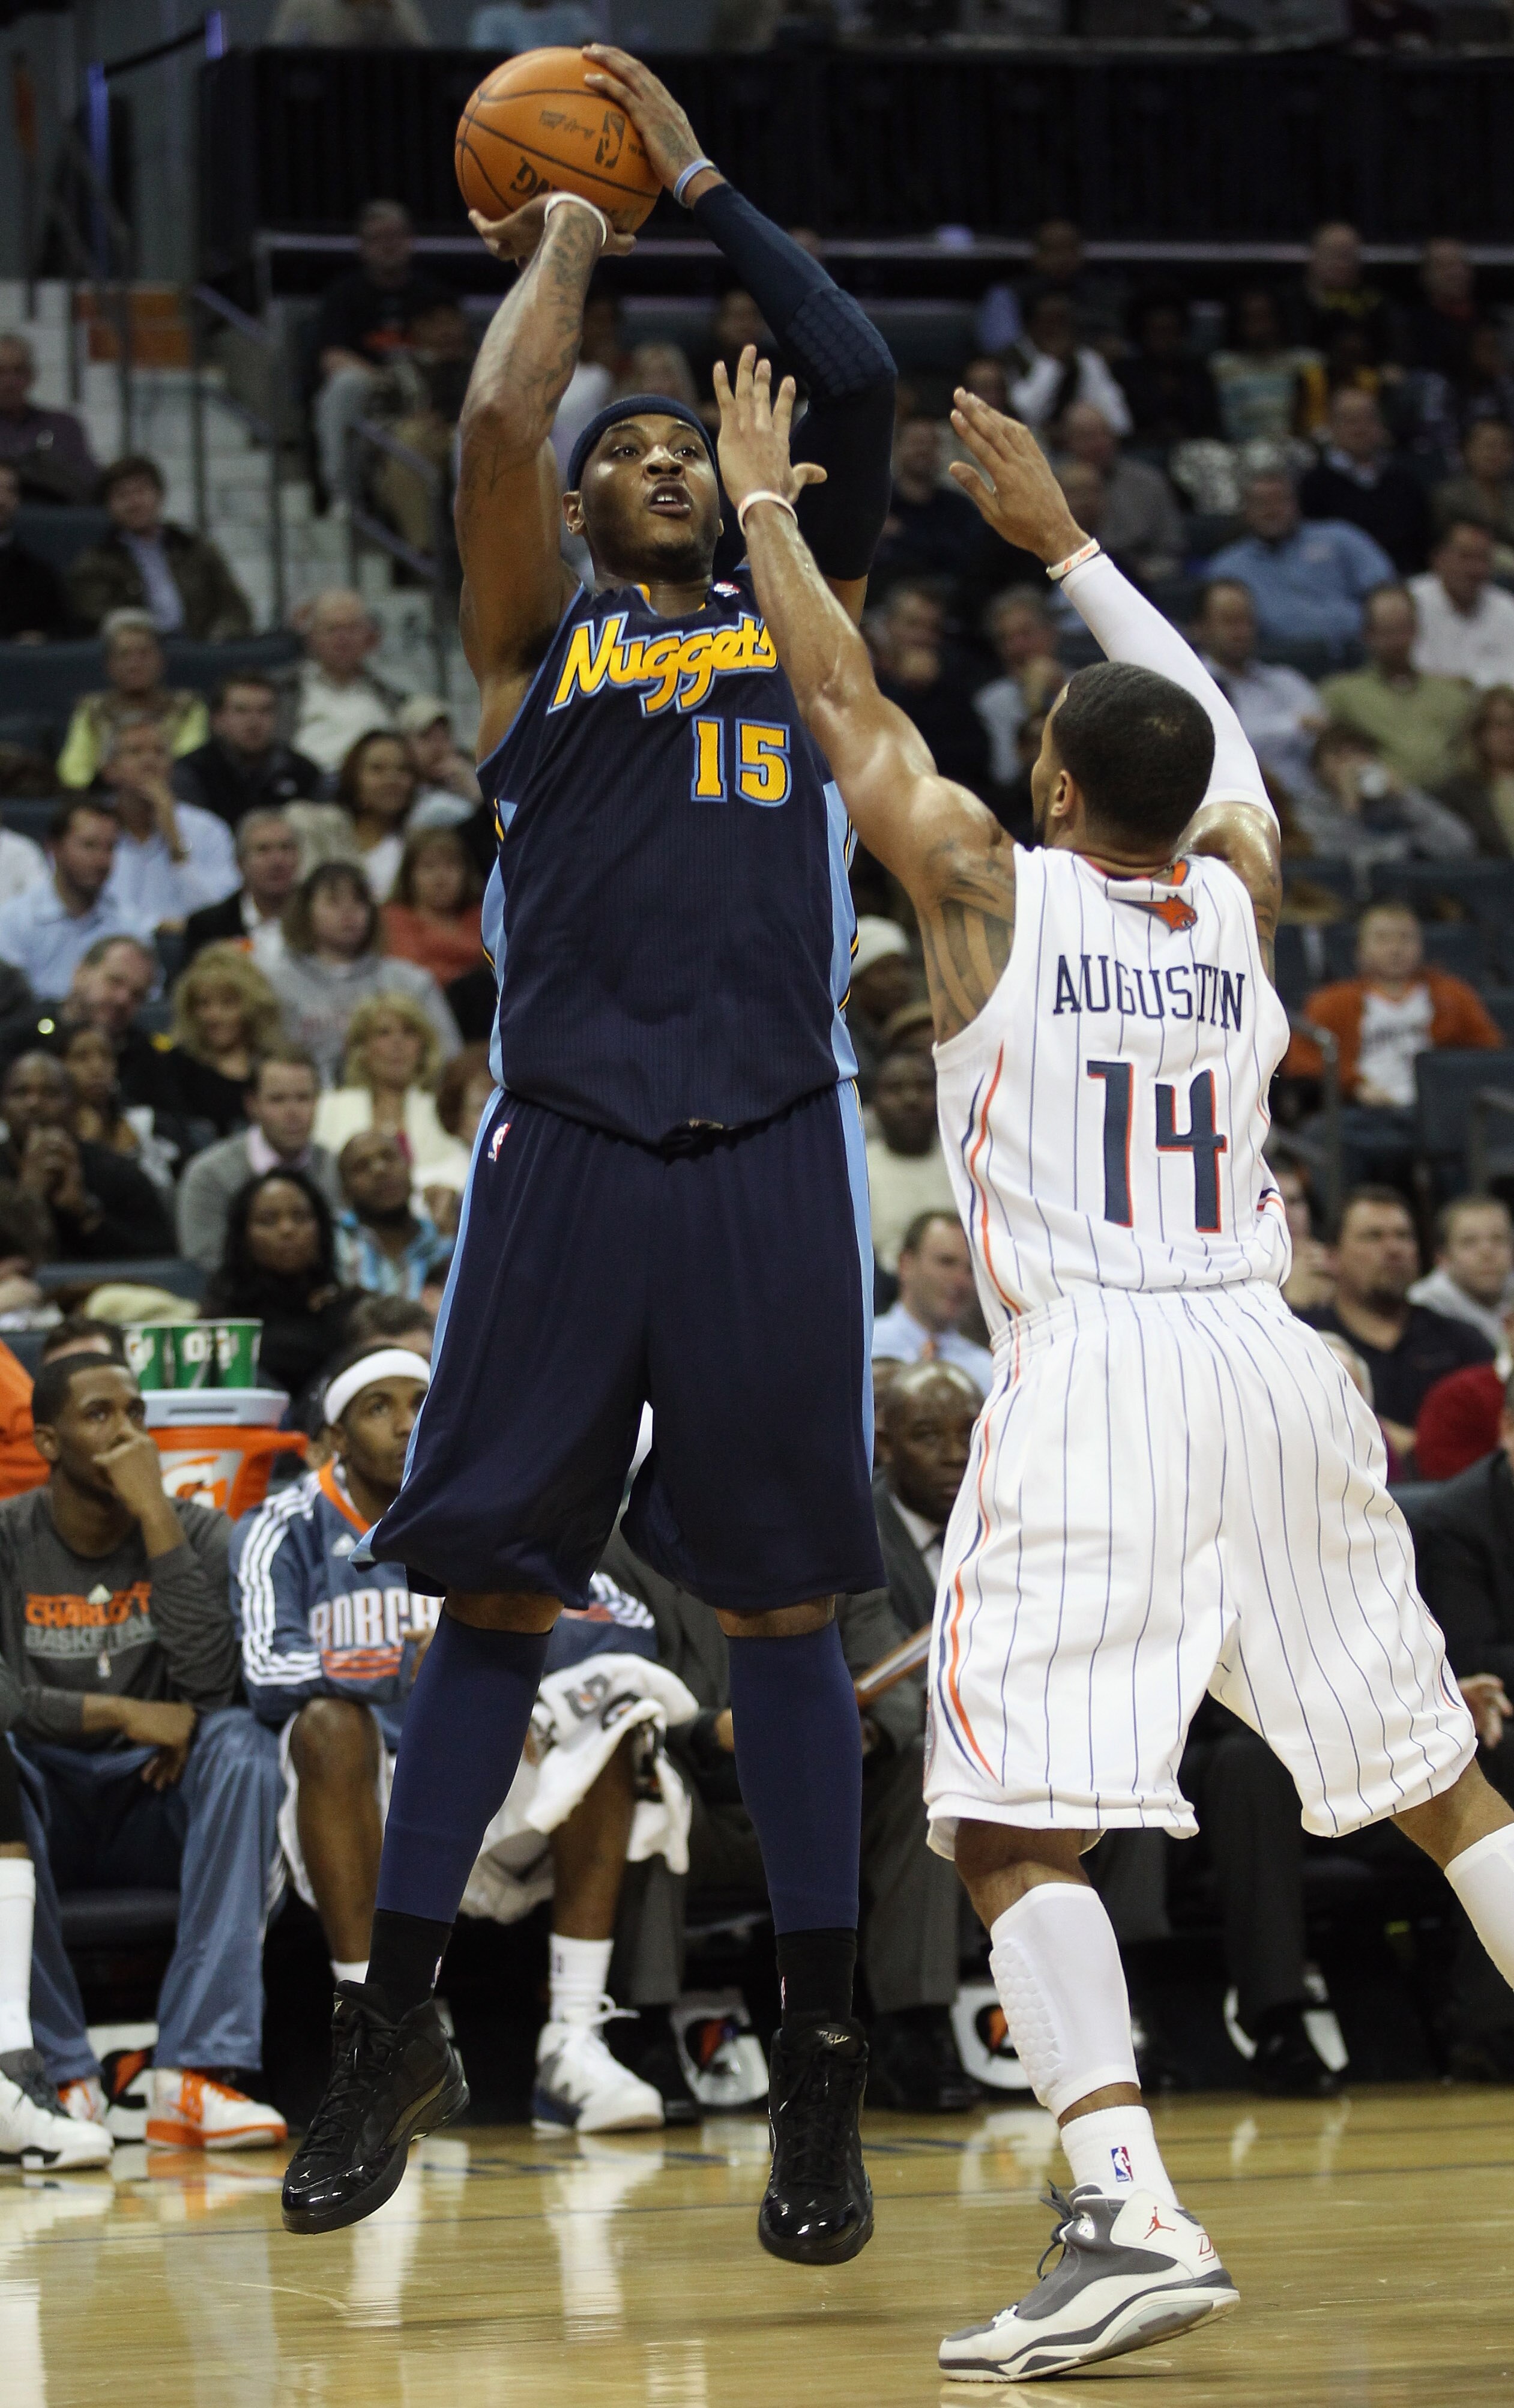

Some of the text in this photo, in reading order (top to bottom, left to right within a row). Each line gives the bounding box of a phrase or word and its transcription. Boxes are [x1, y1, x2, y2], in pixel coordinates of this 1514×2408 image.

[546, 611, 779, 718] Nuggets
[691, 715, 792, 807] 15
[1053, 953, 1246, 1033] AUGUSTIN
[1086, 1060, 1227, 1233] 14
